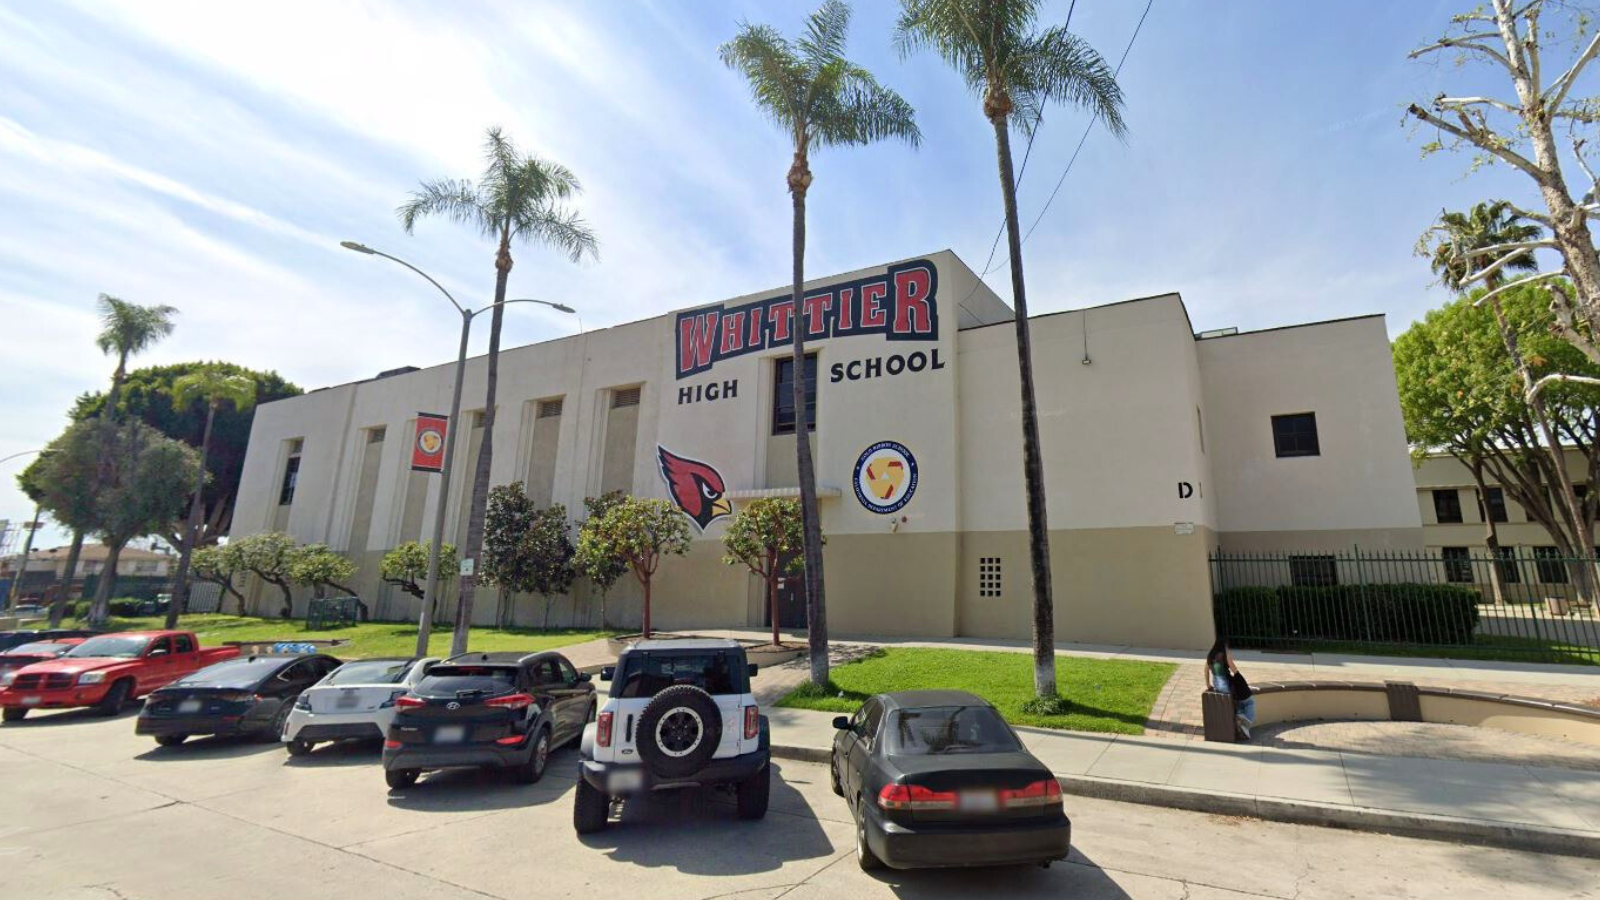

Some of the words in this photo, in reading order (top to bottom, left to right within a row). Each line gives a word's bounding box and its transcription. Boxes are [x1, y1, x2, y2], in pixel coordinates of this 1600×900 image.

[679, 265, 932, 373] WHITTIER
[678, 379, 738, 405] HIGH
[830, 348, 946, 382] SCHOOL
[1178, 481, 1194, 499] D
